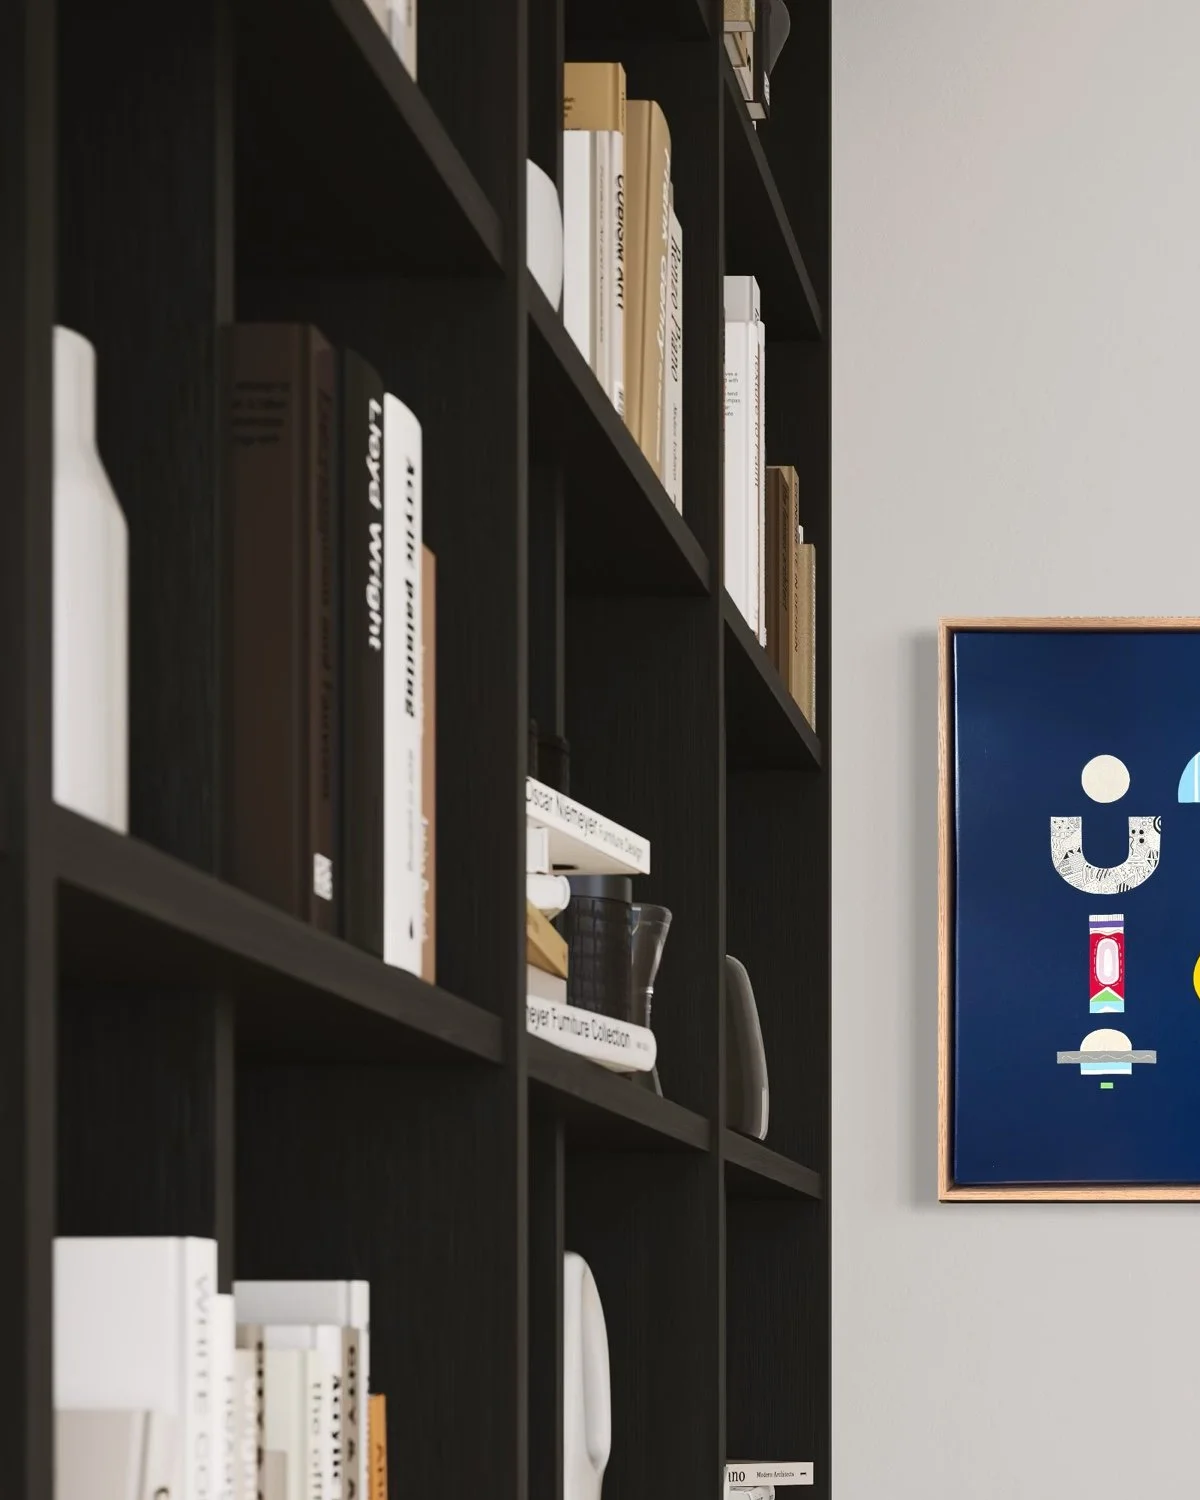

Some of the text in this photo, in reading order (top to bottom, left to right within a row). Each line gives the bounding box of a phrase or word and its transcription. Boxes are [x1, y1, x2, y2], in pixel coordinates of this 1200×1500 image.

[670, 234, 682, 384] Renzo Piano
[366, 398, 382, 650] Lloyd Wright
[551, 1007, 591, 1038] Furniture
[592, 1018, 631, 1049] Collection
